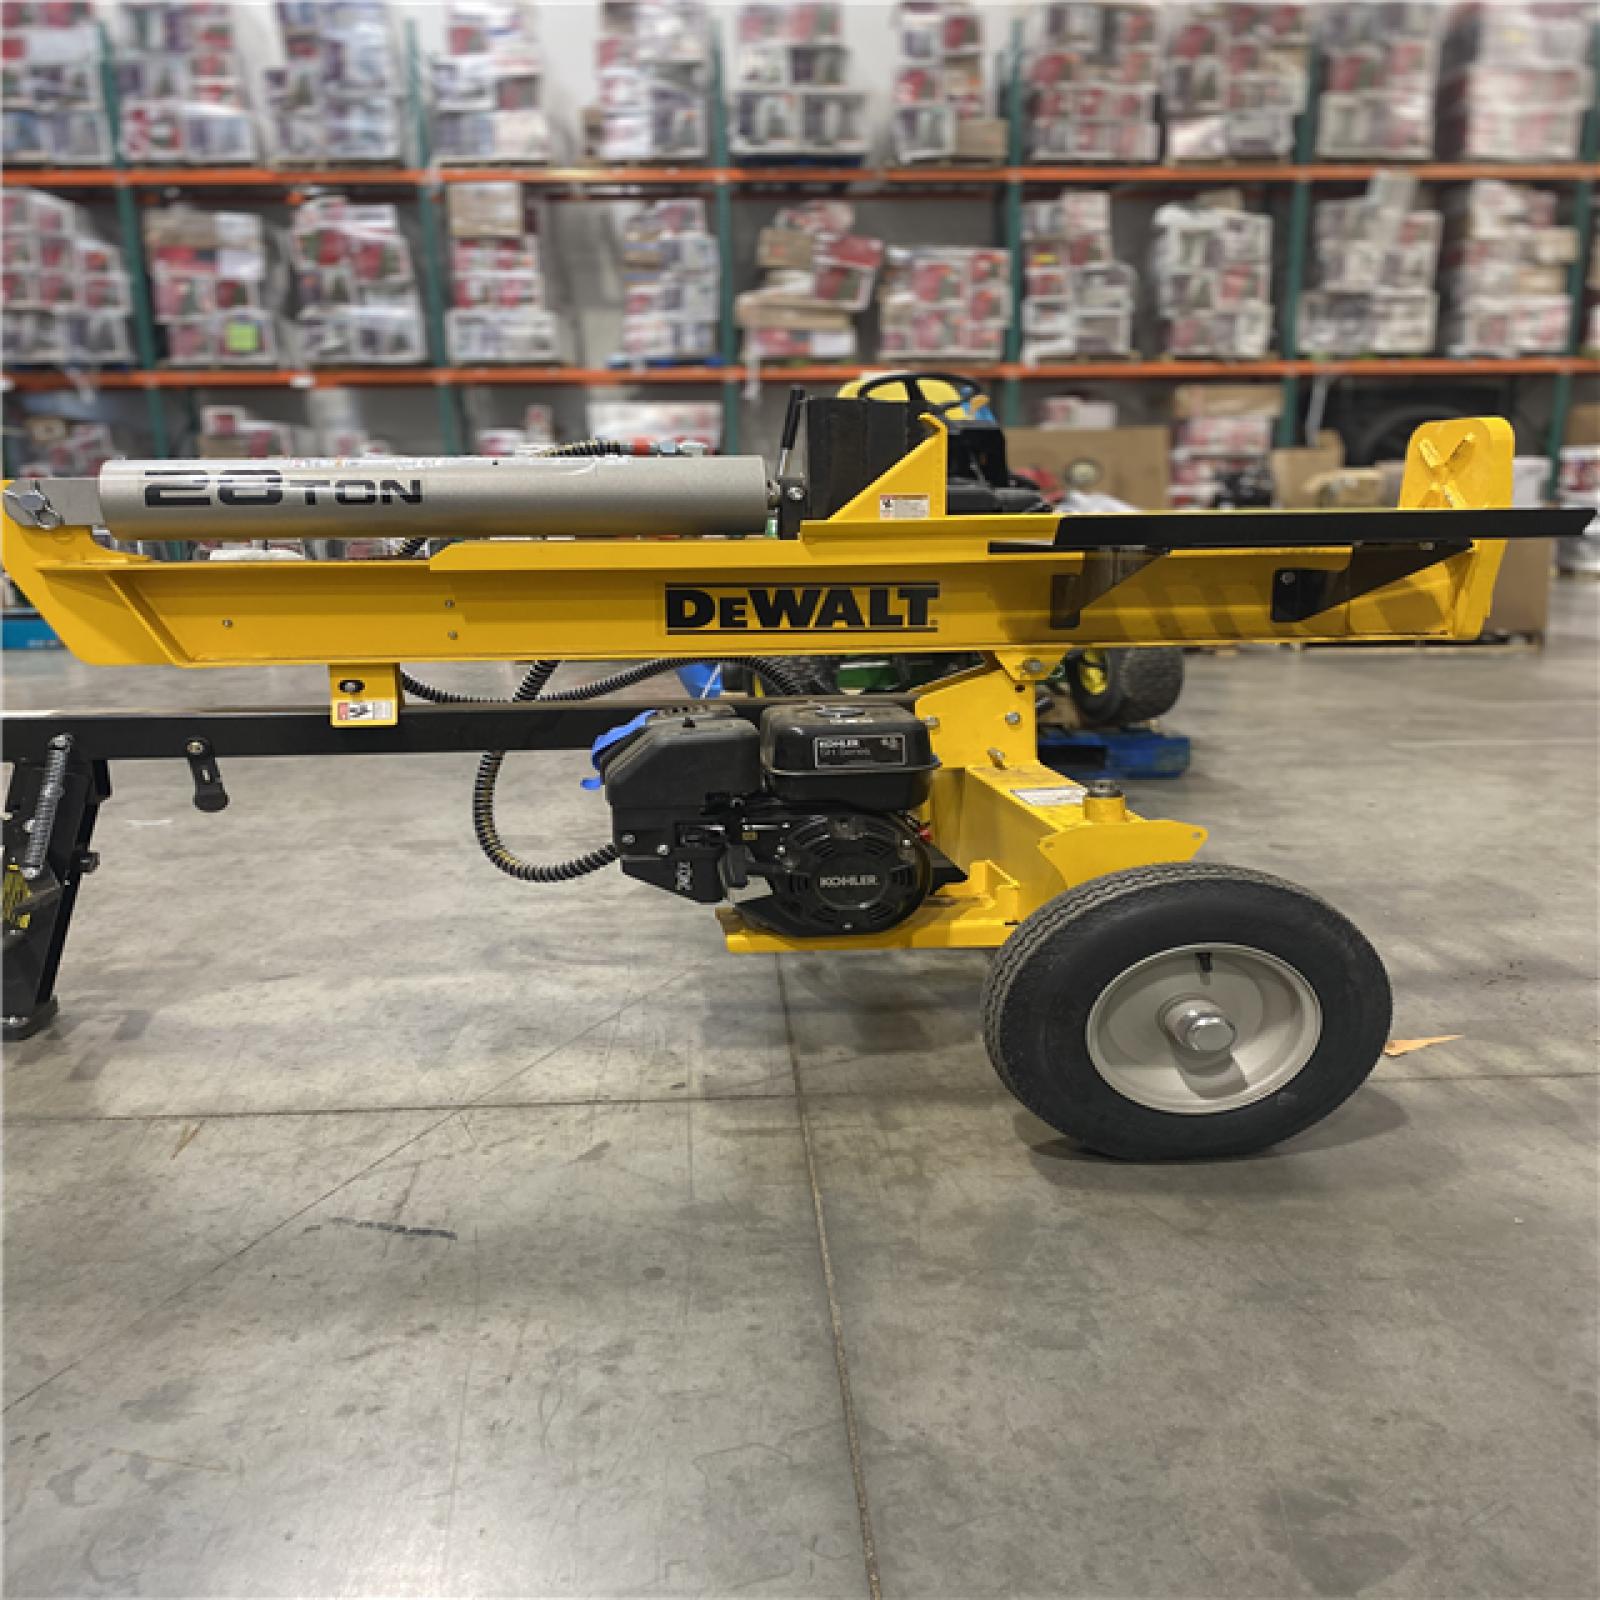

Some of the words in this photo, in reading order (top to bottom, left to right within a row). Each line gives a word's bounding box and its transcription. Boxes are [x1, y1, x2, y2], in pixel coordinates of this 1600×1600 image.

[145, 470, 283, 506] 28
[290, 479, 422, 505] TON
[819, 875, 880, 888] KOHLER
